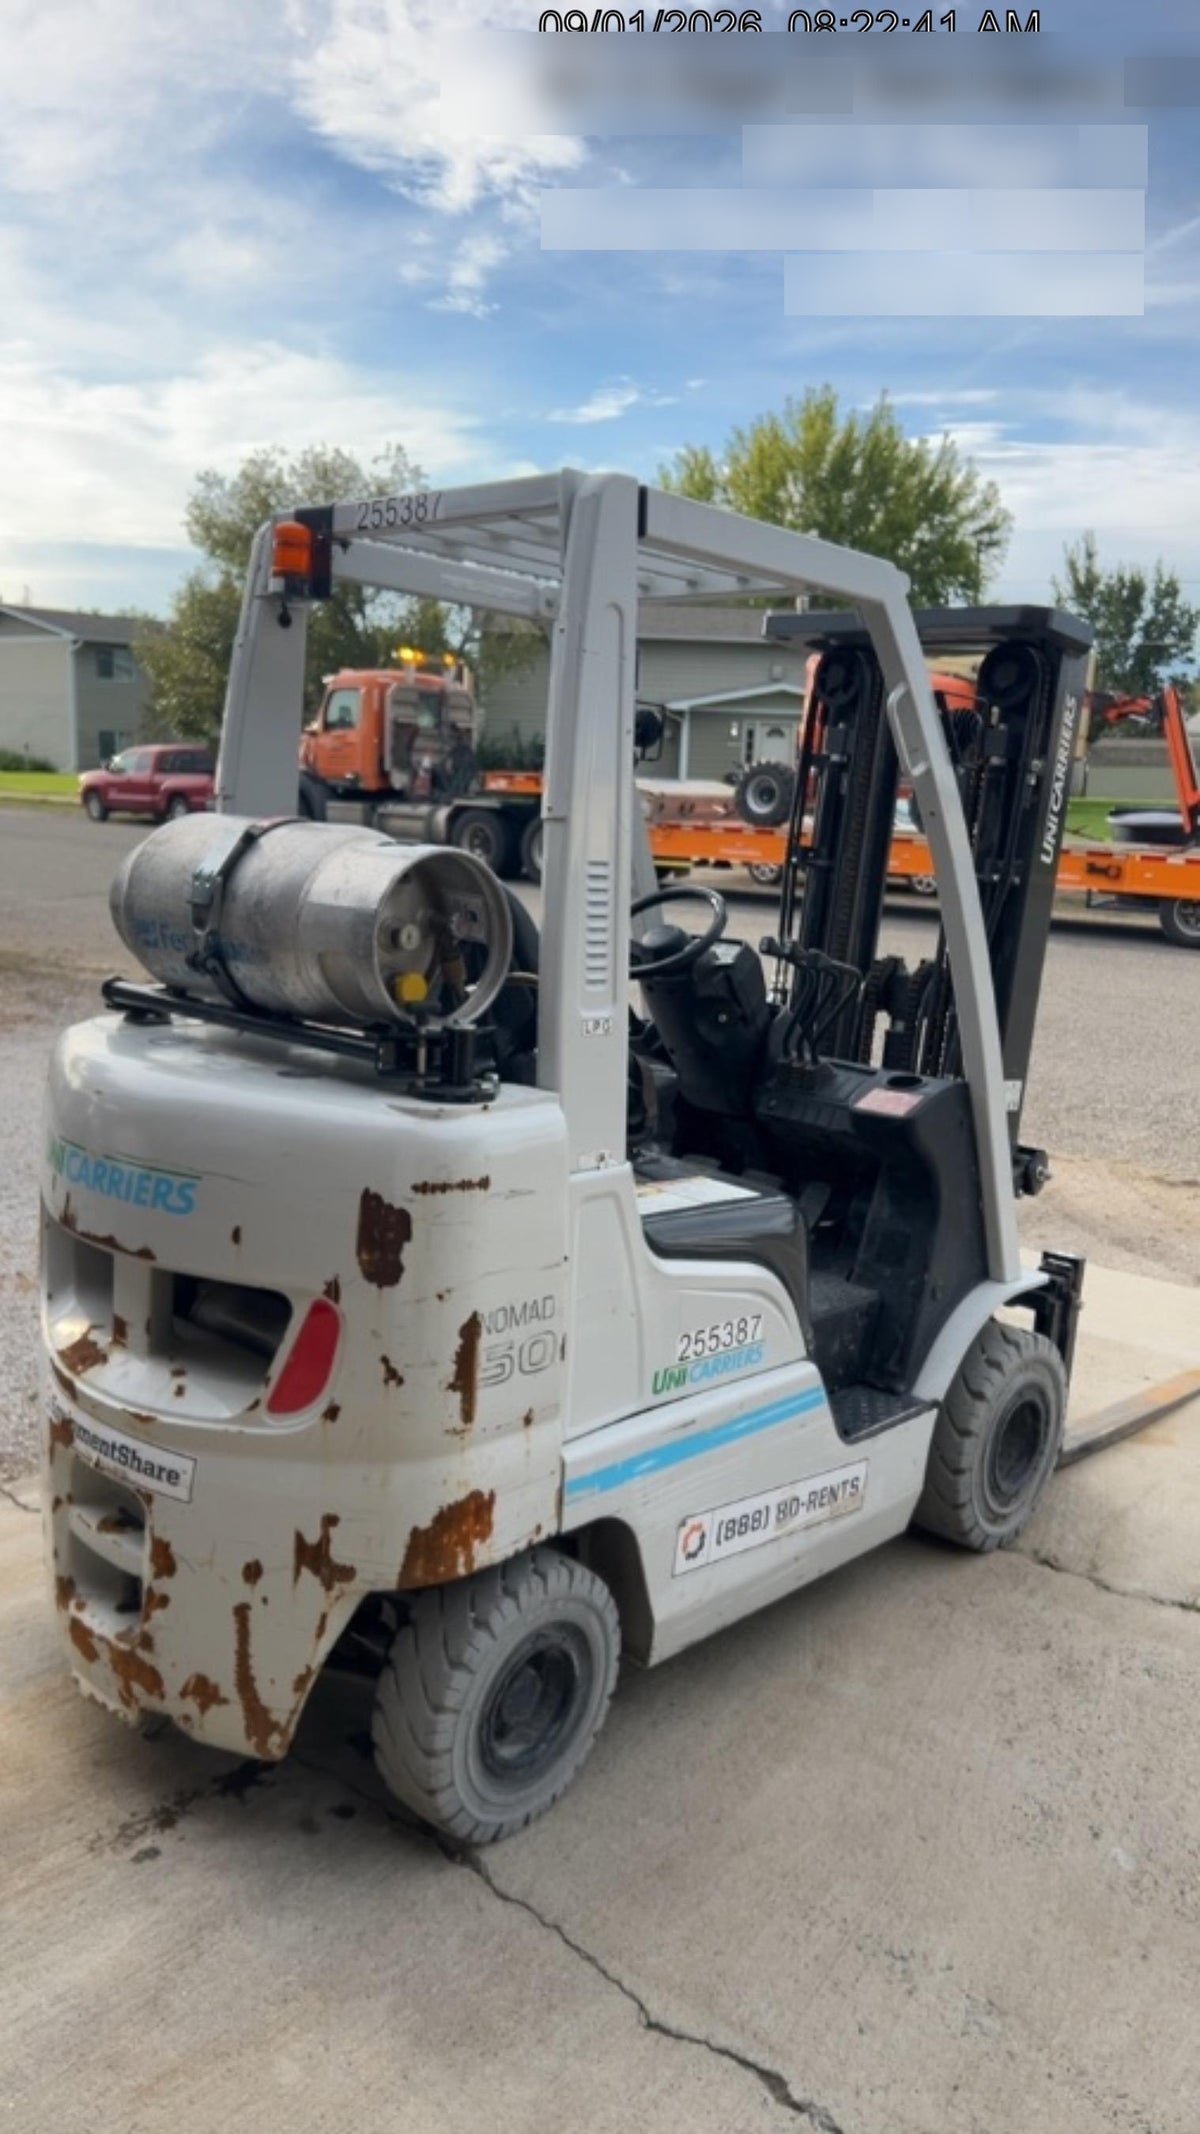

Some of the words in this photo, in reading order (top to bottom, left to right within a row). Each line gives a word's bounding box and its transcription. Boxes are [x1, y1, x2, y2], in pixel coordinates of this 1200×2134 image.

[357, 491, 443, 531] 255387
[1040, 694, 1077, 865] UNICARRIERS
[479, 1294, 556, 1336] NOMAD
[678, 1315, 763, 1362] 255387
[478, 1329, 559, 1389] 50
[651, 1346, 764, 1395] UNICARRIERS
[715, 1505, 770, 1546] (888)
